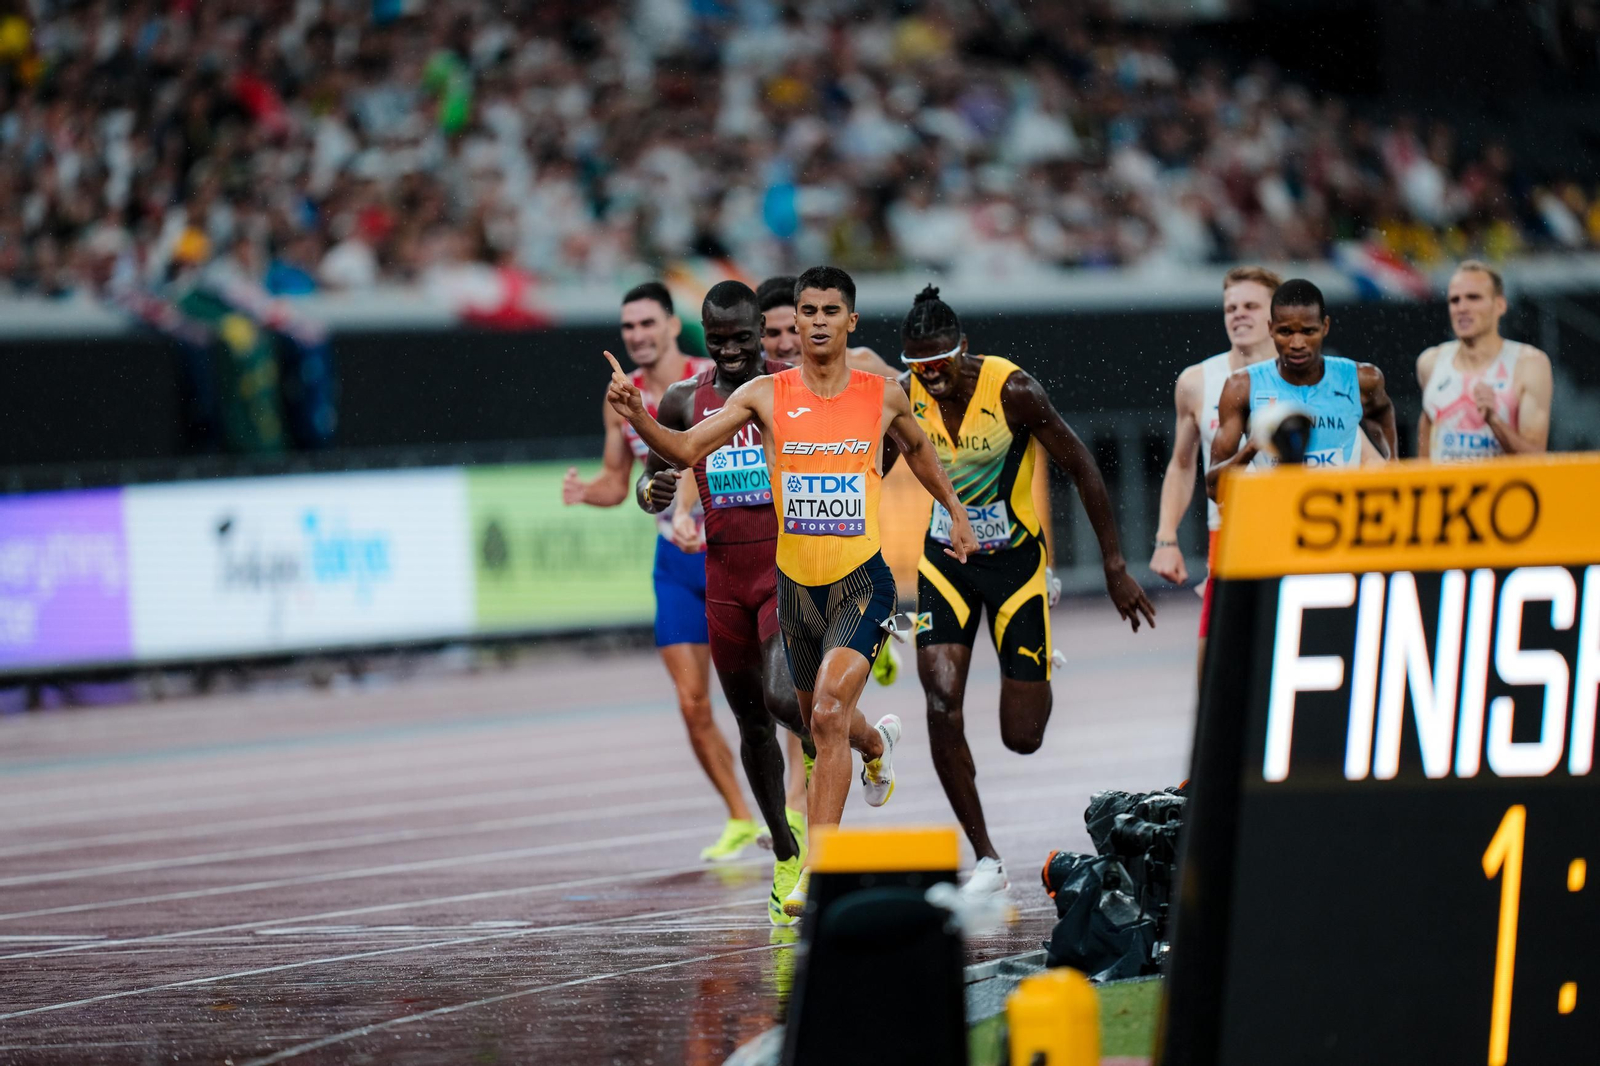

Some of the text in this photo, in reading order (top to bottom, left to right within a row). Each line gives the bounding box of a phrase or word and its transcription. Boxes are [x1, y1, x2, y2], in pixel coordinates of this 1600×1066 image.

[781, 438, 872, 455] ESPAÑA
[926, 432, 991, 451] AMAICA
[1303, 452, 1339, 468] DK
[710, 469, 771, 491] WANYON
[801, 475, 859, 493] TDK
[786, 498, 862, 517] ATTAOUI
[966, 506, 999, 521] DK
[1296, 481, 1541, 550] SEIKO
